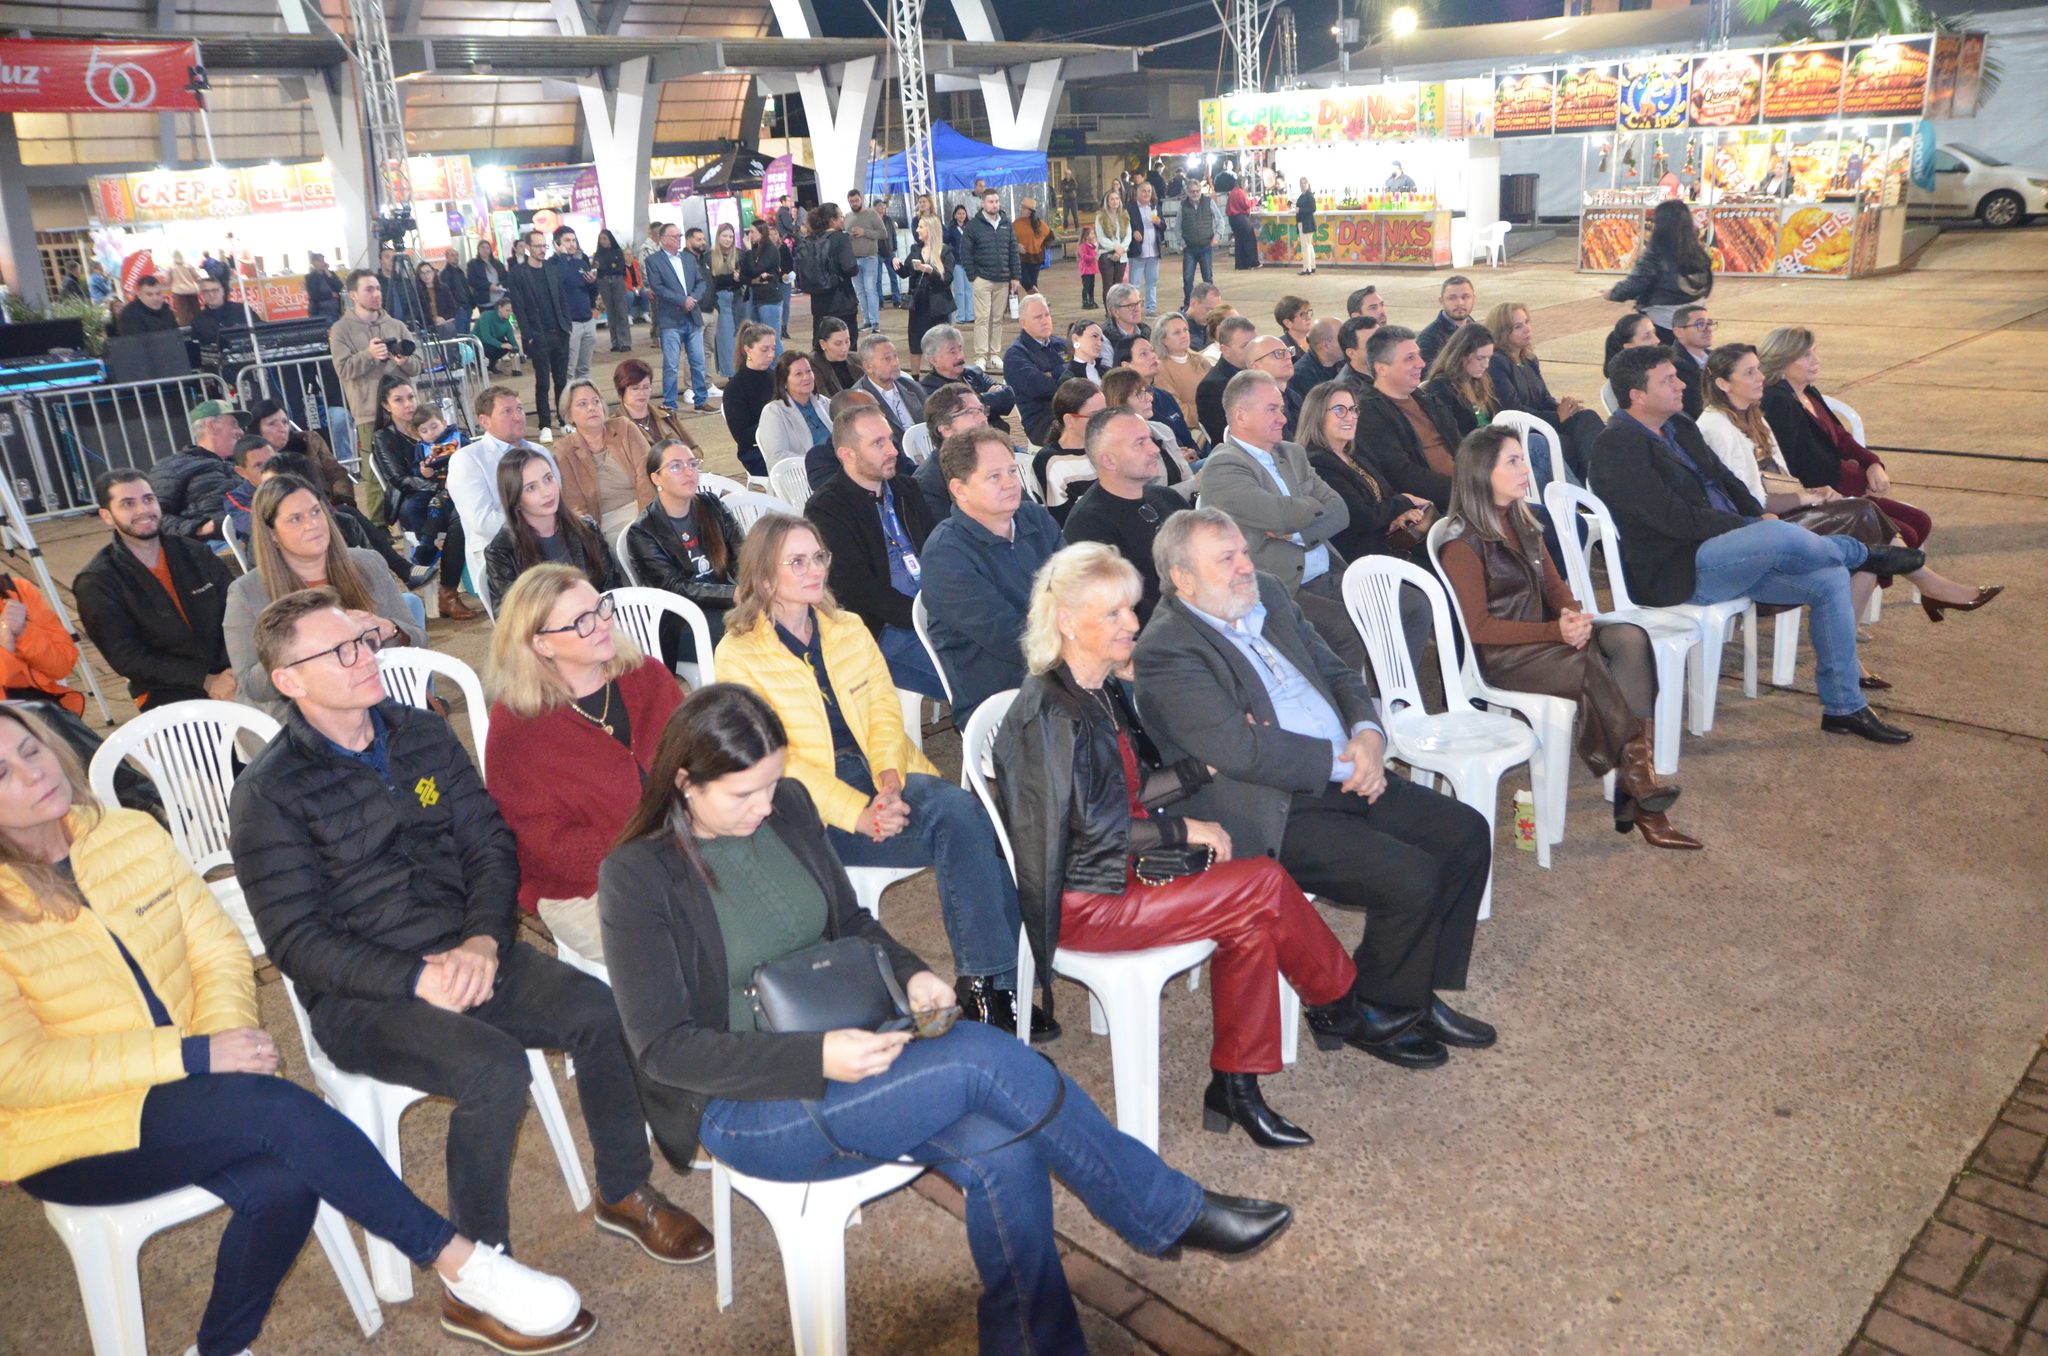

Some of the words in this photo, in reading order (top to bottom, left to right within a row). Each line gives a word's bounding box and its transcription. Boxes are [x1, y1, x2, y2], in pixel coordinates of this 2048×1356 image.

[0, 56, 40, 85] uz
[1701, 68, 1751, 88] Morango
[1318, 92, 1417, 126] DRINKS
[135, 178, 239, 205] CREPES
[1338, 219, 1433, 246] DRINKS
[307, 397, 319, 425] LIGHT
